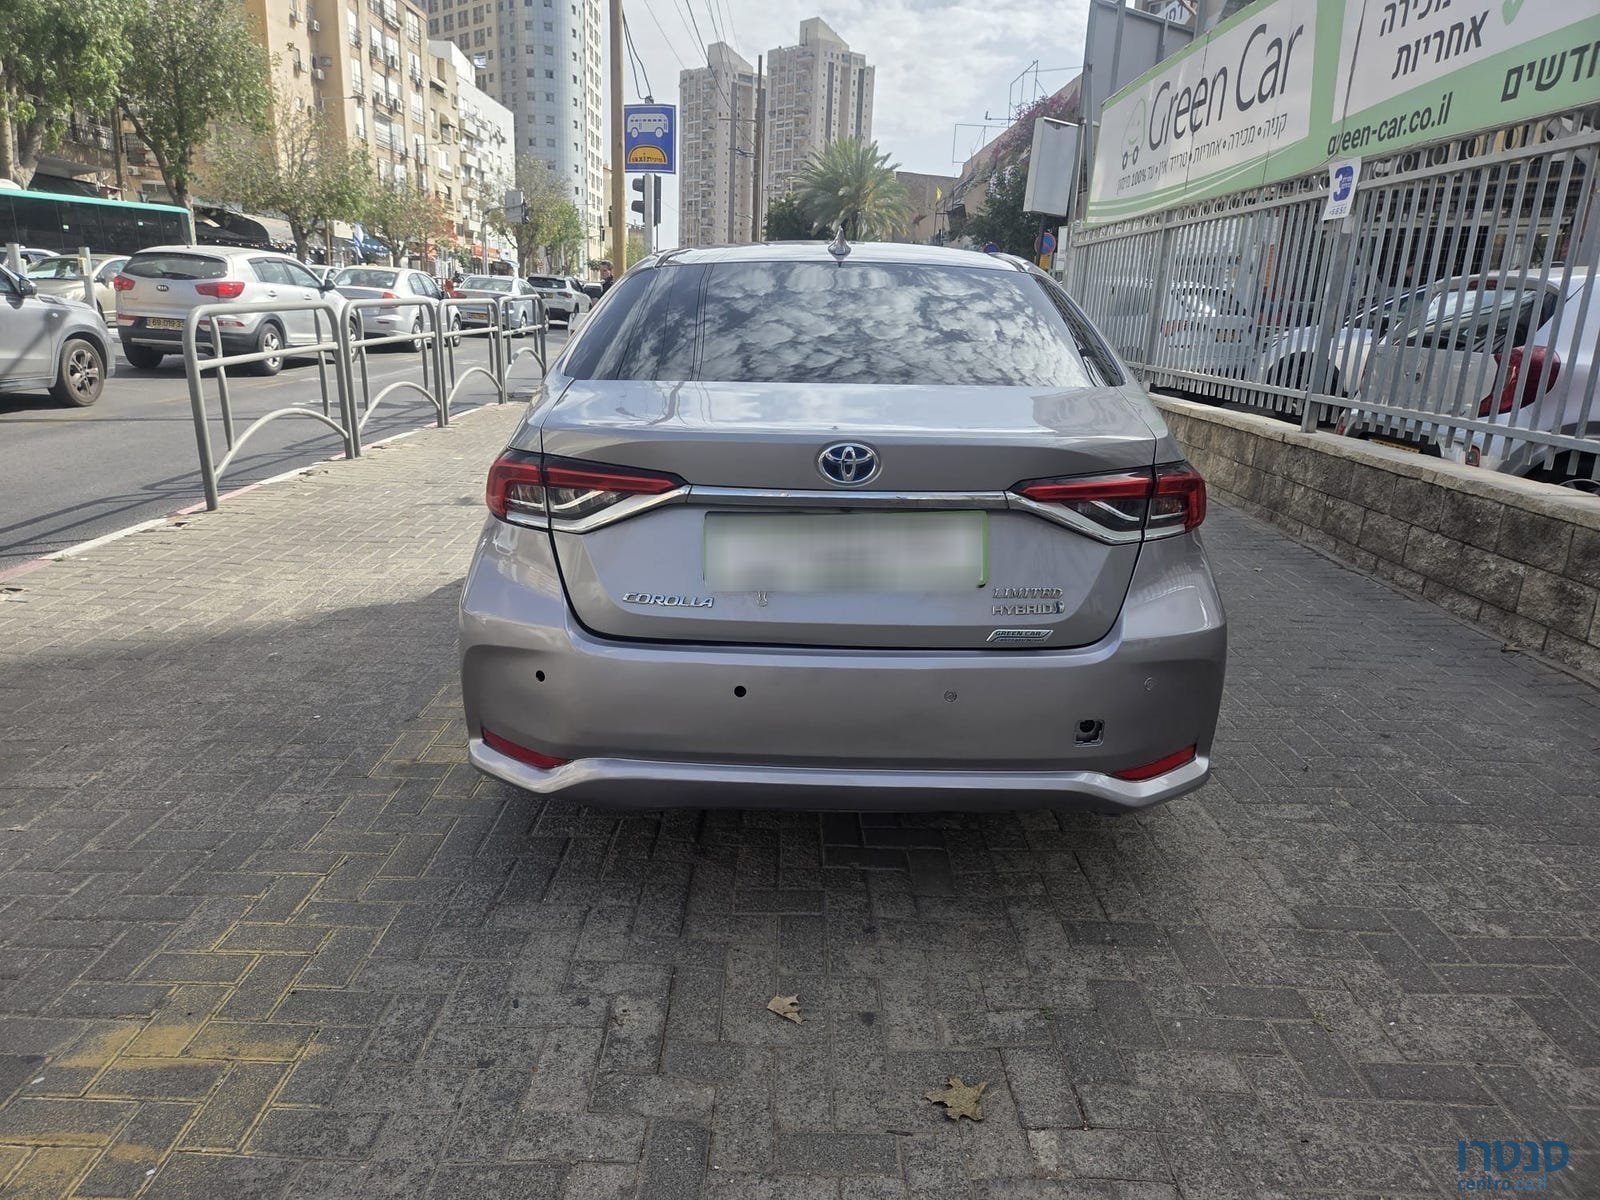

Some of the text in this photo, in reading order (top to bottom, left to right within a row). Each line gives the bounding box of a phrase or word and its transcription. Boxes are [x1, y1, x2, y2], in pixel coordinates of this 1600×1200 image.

[1391, 10, 1490, 80] אחריות
[1149, 23, 1304, 151] Green Car
[1228, 125, 1256, 151] מכירה
[1262, 113, 1288, 140] קניה
[1192, 139, 1222, 164] אחריות
[623, 592, 714, 608] COROLLA
[992, 587, 1063, 599] LIMITED
[992, 604, 1054, 616] HYBRID
